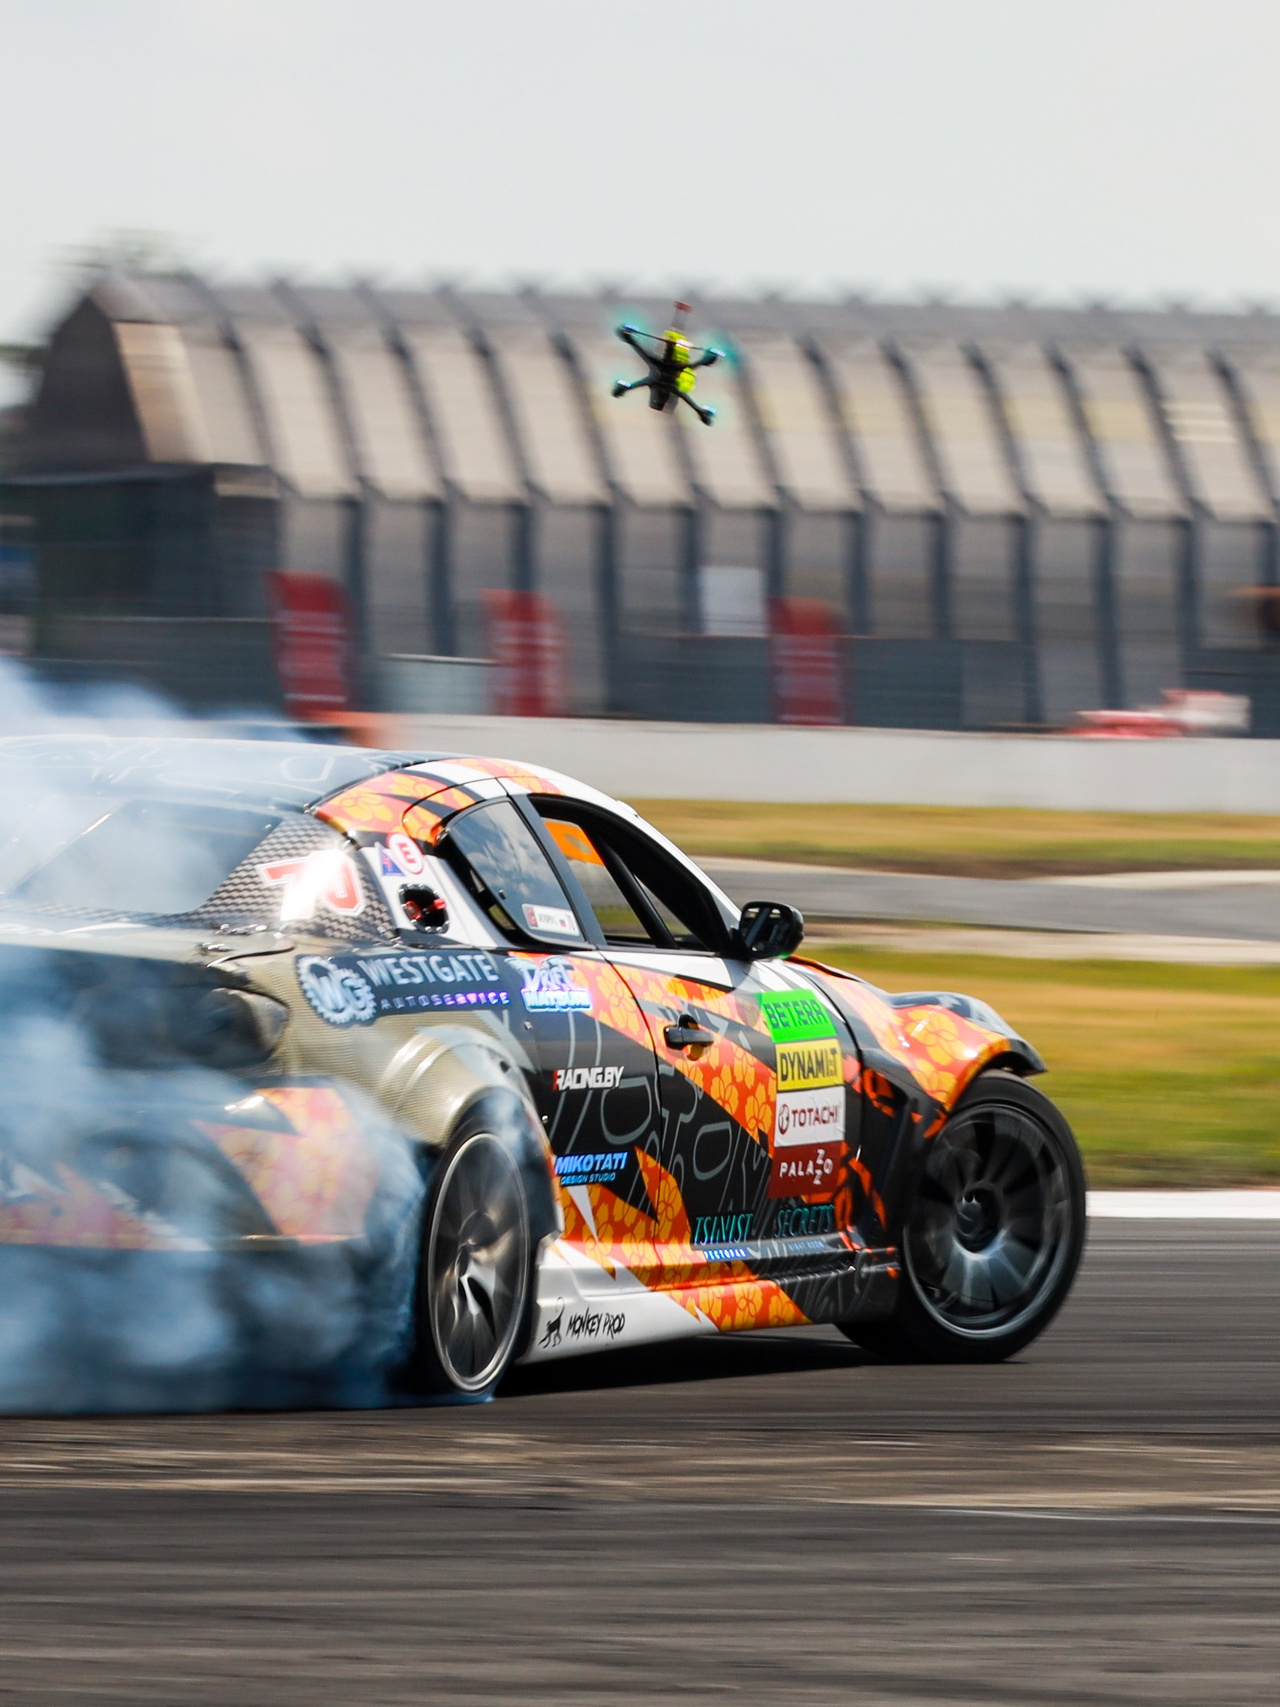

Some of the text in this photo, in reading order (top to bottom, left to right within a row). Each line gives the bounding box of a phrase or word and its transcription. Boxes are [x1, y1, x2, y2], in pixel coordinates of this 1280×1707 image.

[356, 954, 500, 987] WESTGATE
[380, 991, 511, 1010] AUTOSERVICE
[763, 1000, 829, 1029] BETERA
[791, 1105, 839, 1128] TOTACHI
[554, 1152, 628, 1175] MIKOTATI
[561, 1172, 616, 1186] DESIGN STUDIO
[565, 1306, 626, 1340] MONKEY PROD
